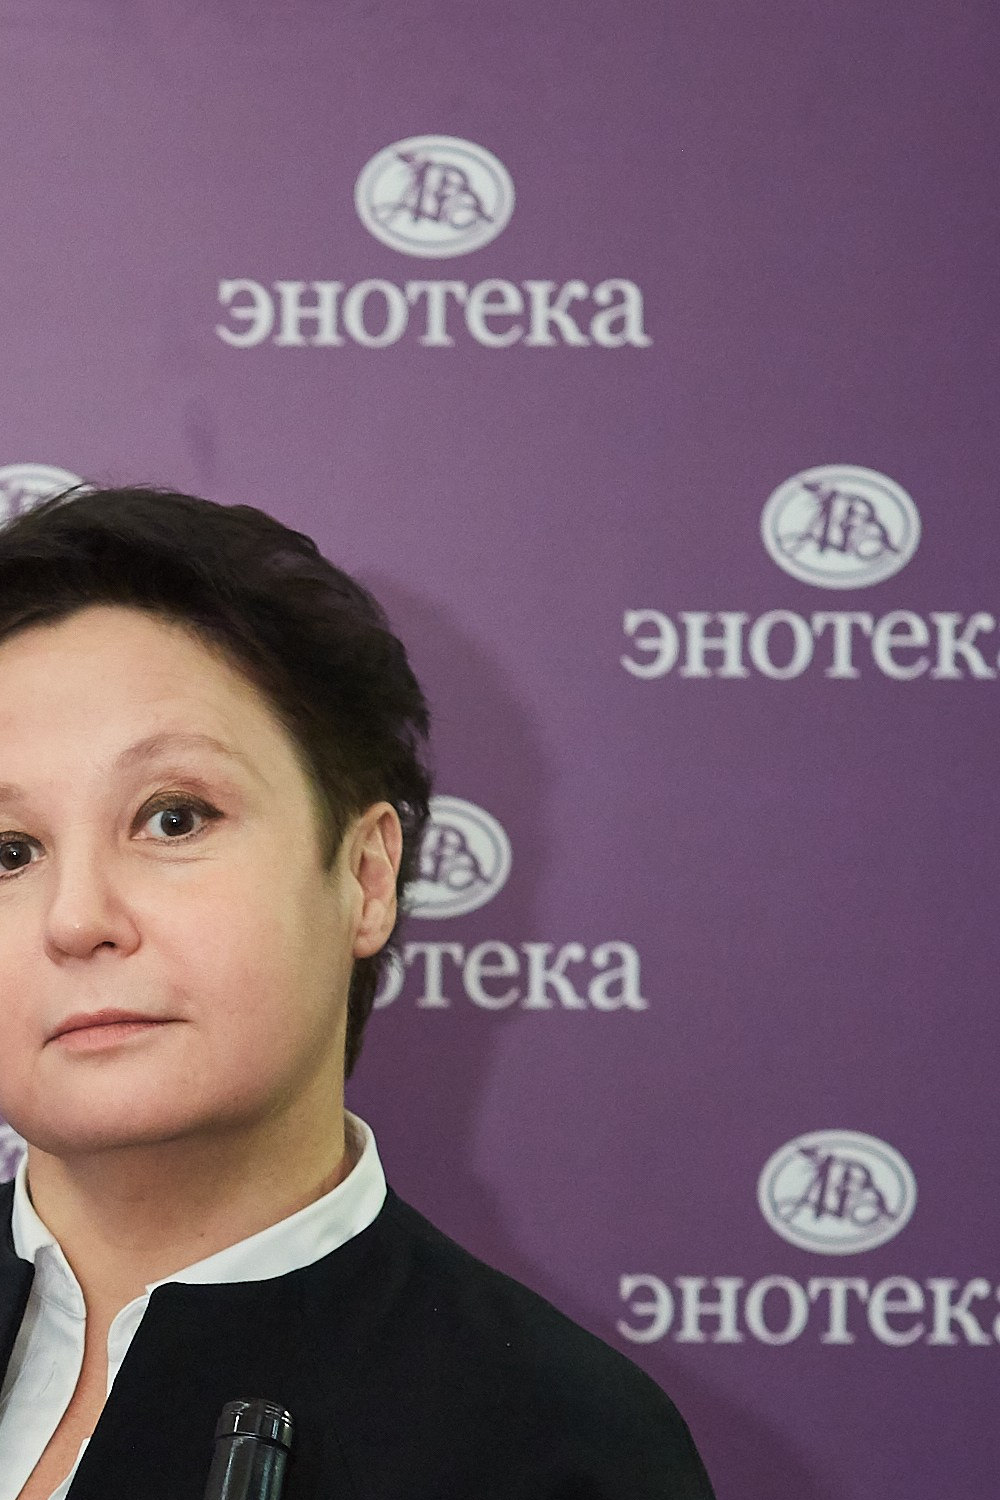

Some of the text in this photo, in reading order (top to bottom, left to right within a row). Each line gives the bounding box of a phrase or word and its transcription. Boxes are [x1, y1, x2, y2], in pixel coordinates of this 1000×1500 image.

[217, 278, 649, 349] энотека
[621, 608, 997, 680] энотек
[619, 1274, 1000, 1346] энотек
